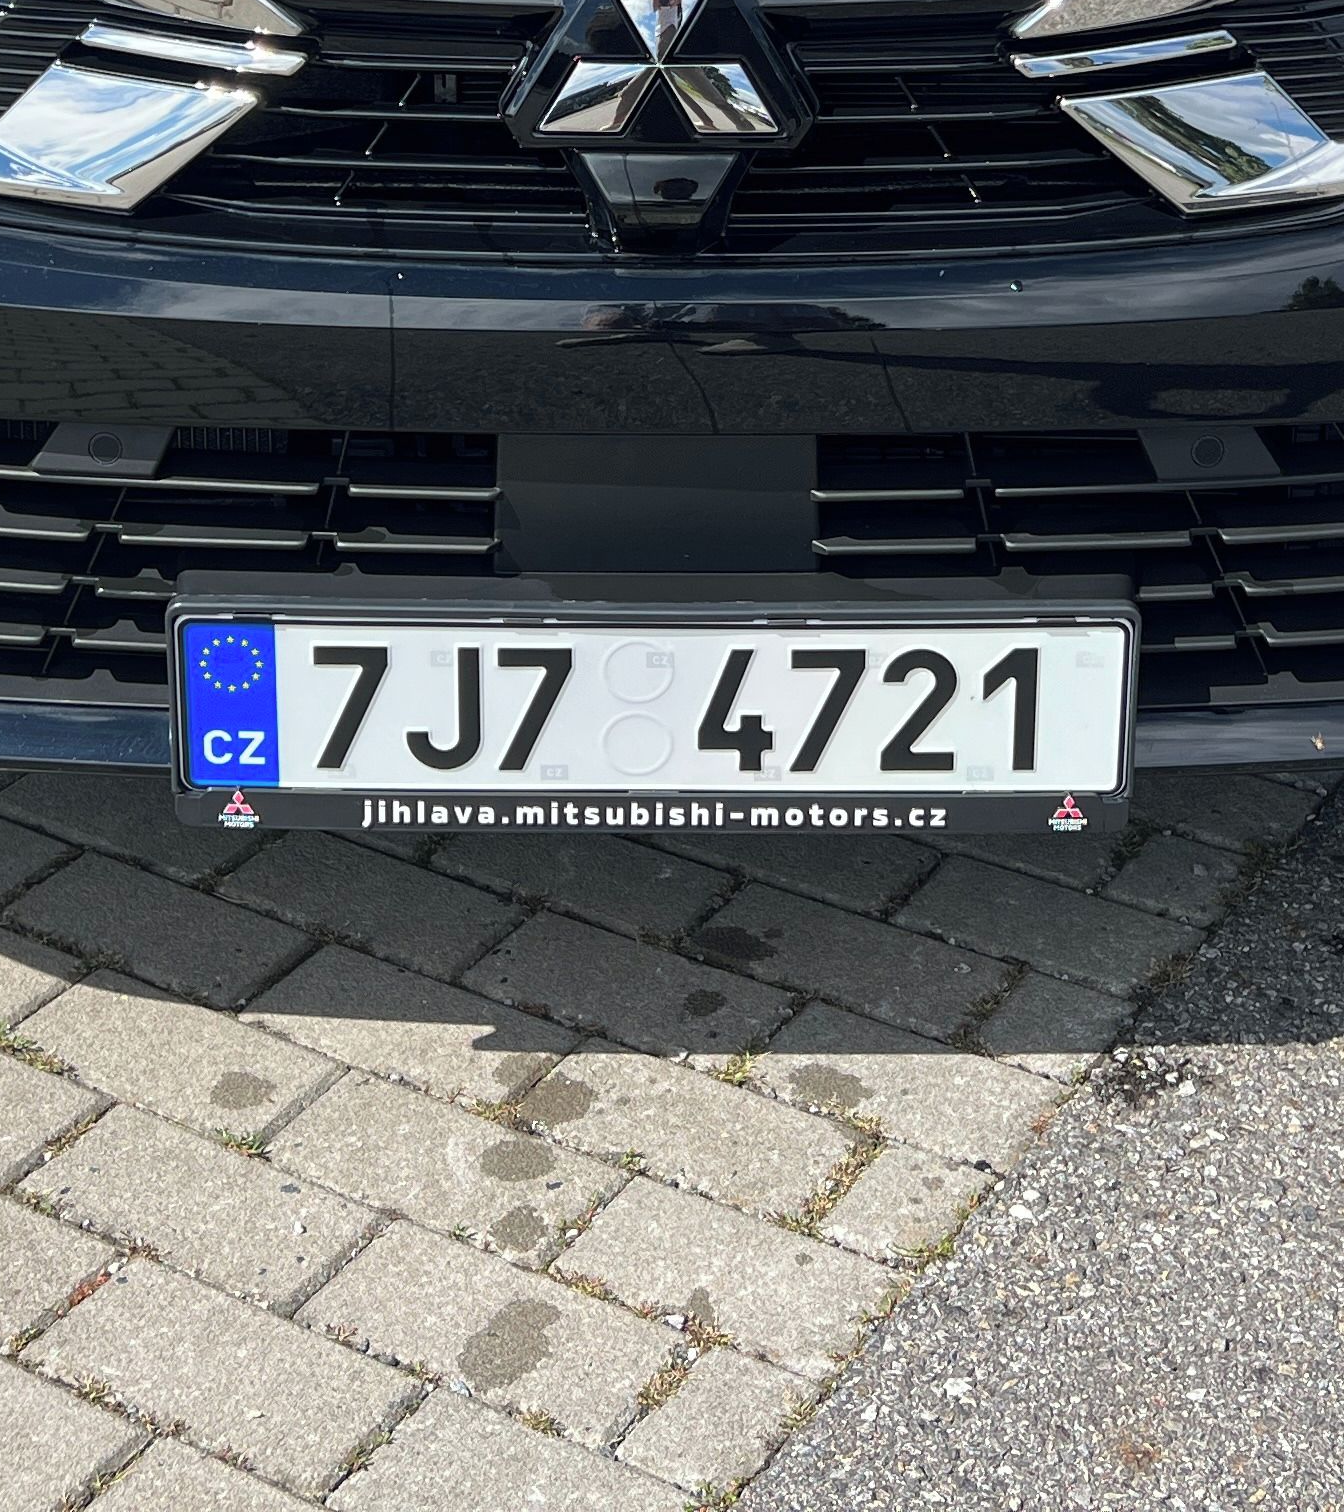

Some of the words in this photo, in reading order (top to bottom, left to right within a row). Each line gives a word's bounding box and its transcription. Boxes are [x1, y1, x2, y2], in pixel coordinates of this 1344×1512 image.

[312, 645, 574, 771] 7J7
[697, 647, 1040, 772] 4721
[203, 729, 266, 765] CZ
[361, 799, 947, 828] jihlava.mitsubishi-motors.cz
